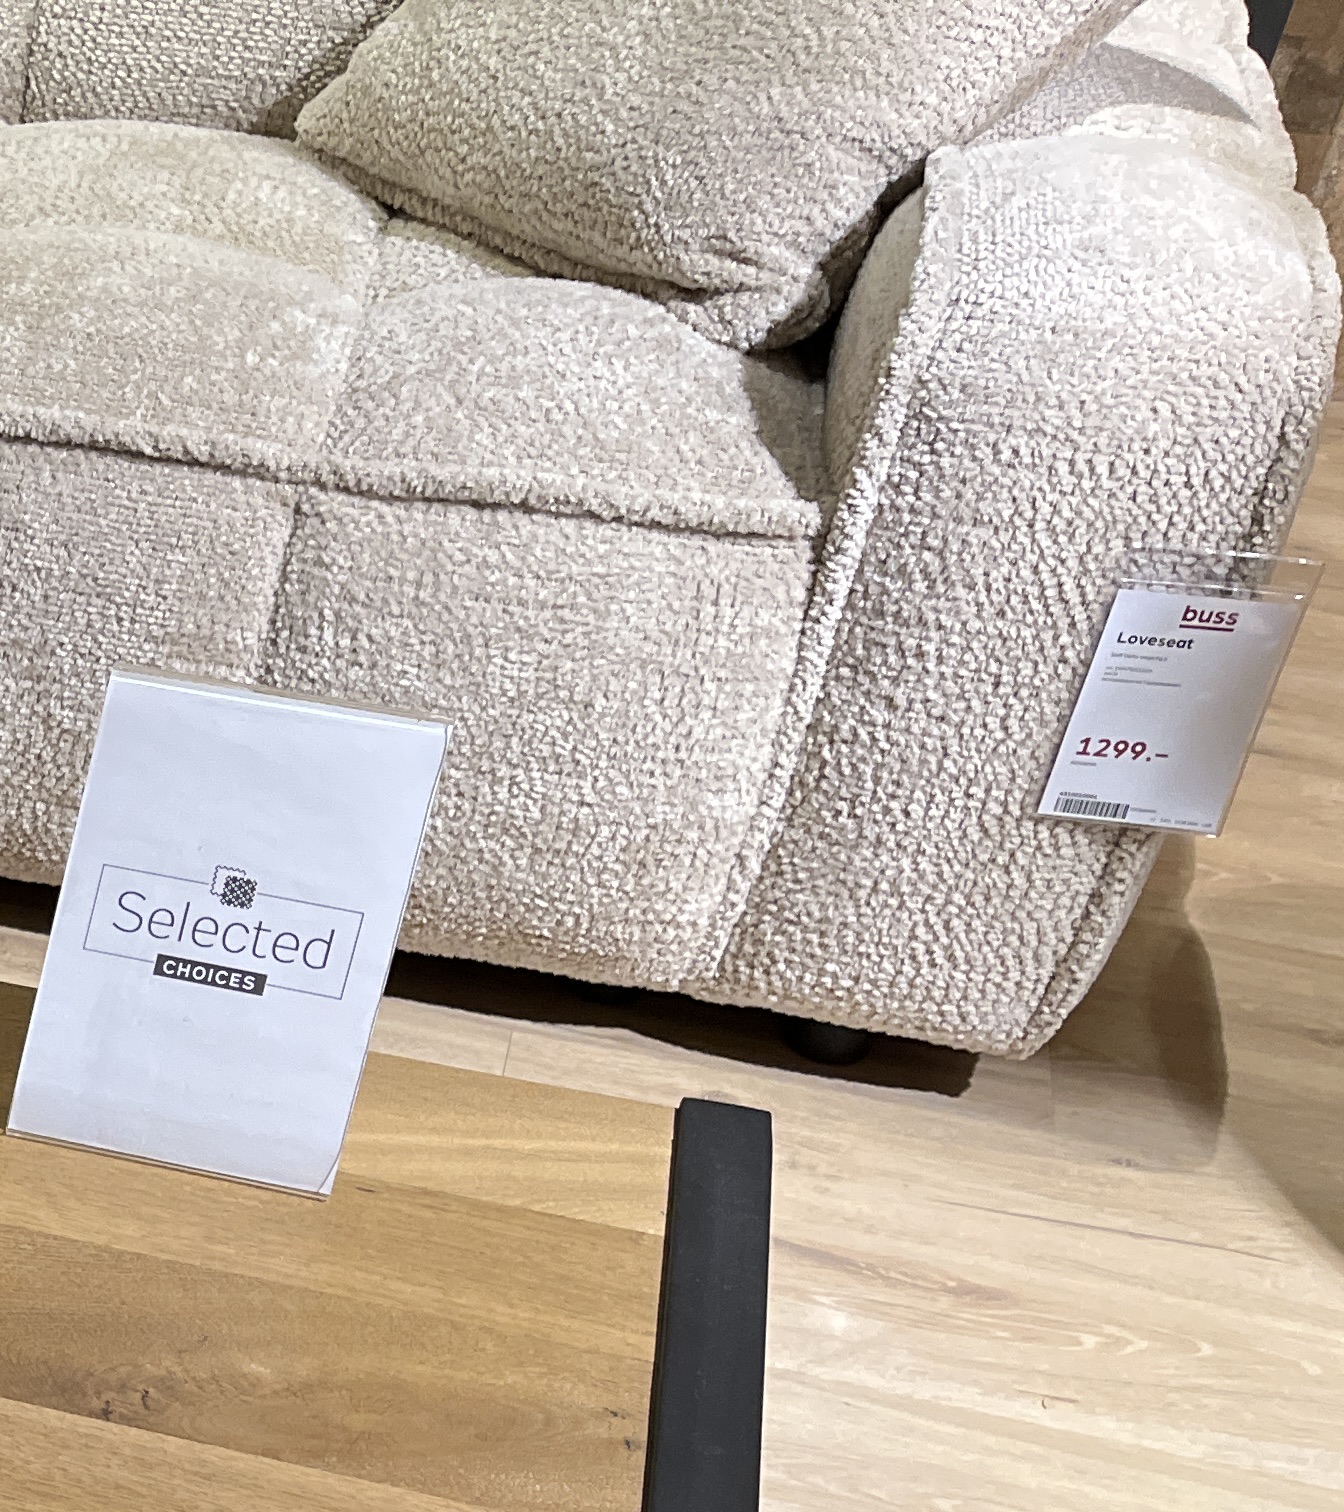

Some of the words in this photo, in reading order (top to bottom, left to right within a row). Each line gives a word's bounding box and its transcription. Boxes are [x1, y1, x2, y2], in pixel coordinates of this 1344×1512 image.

[1180, 605, 1240, 626] buss
[1116, 631, 1195, 650] Loveseat
[111, 889, 335, 971] Selected
[161, 958, 257, 992] CHOICES
